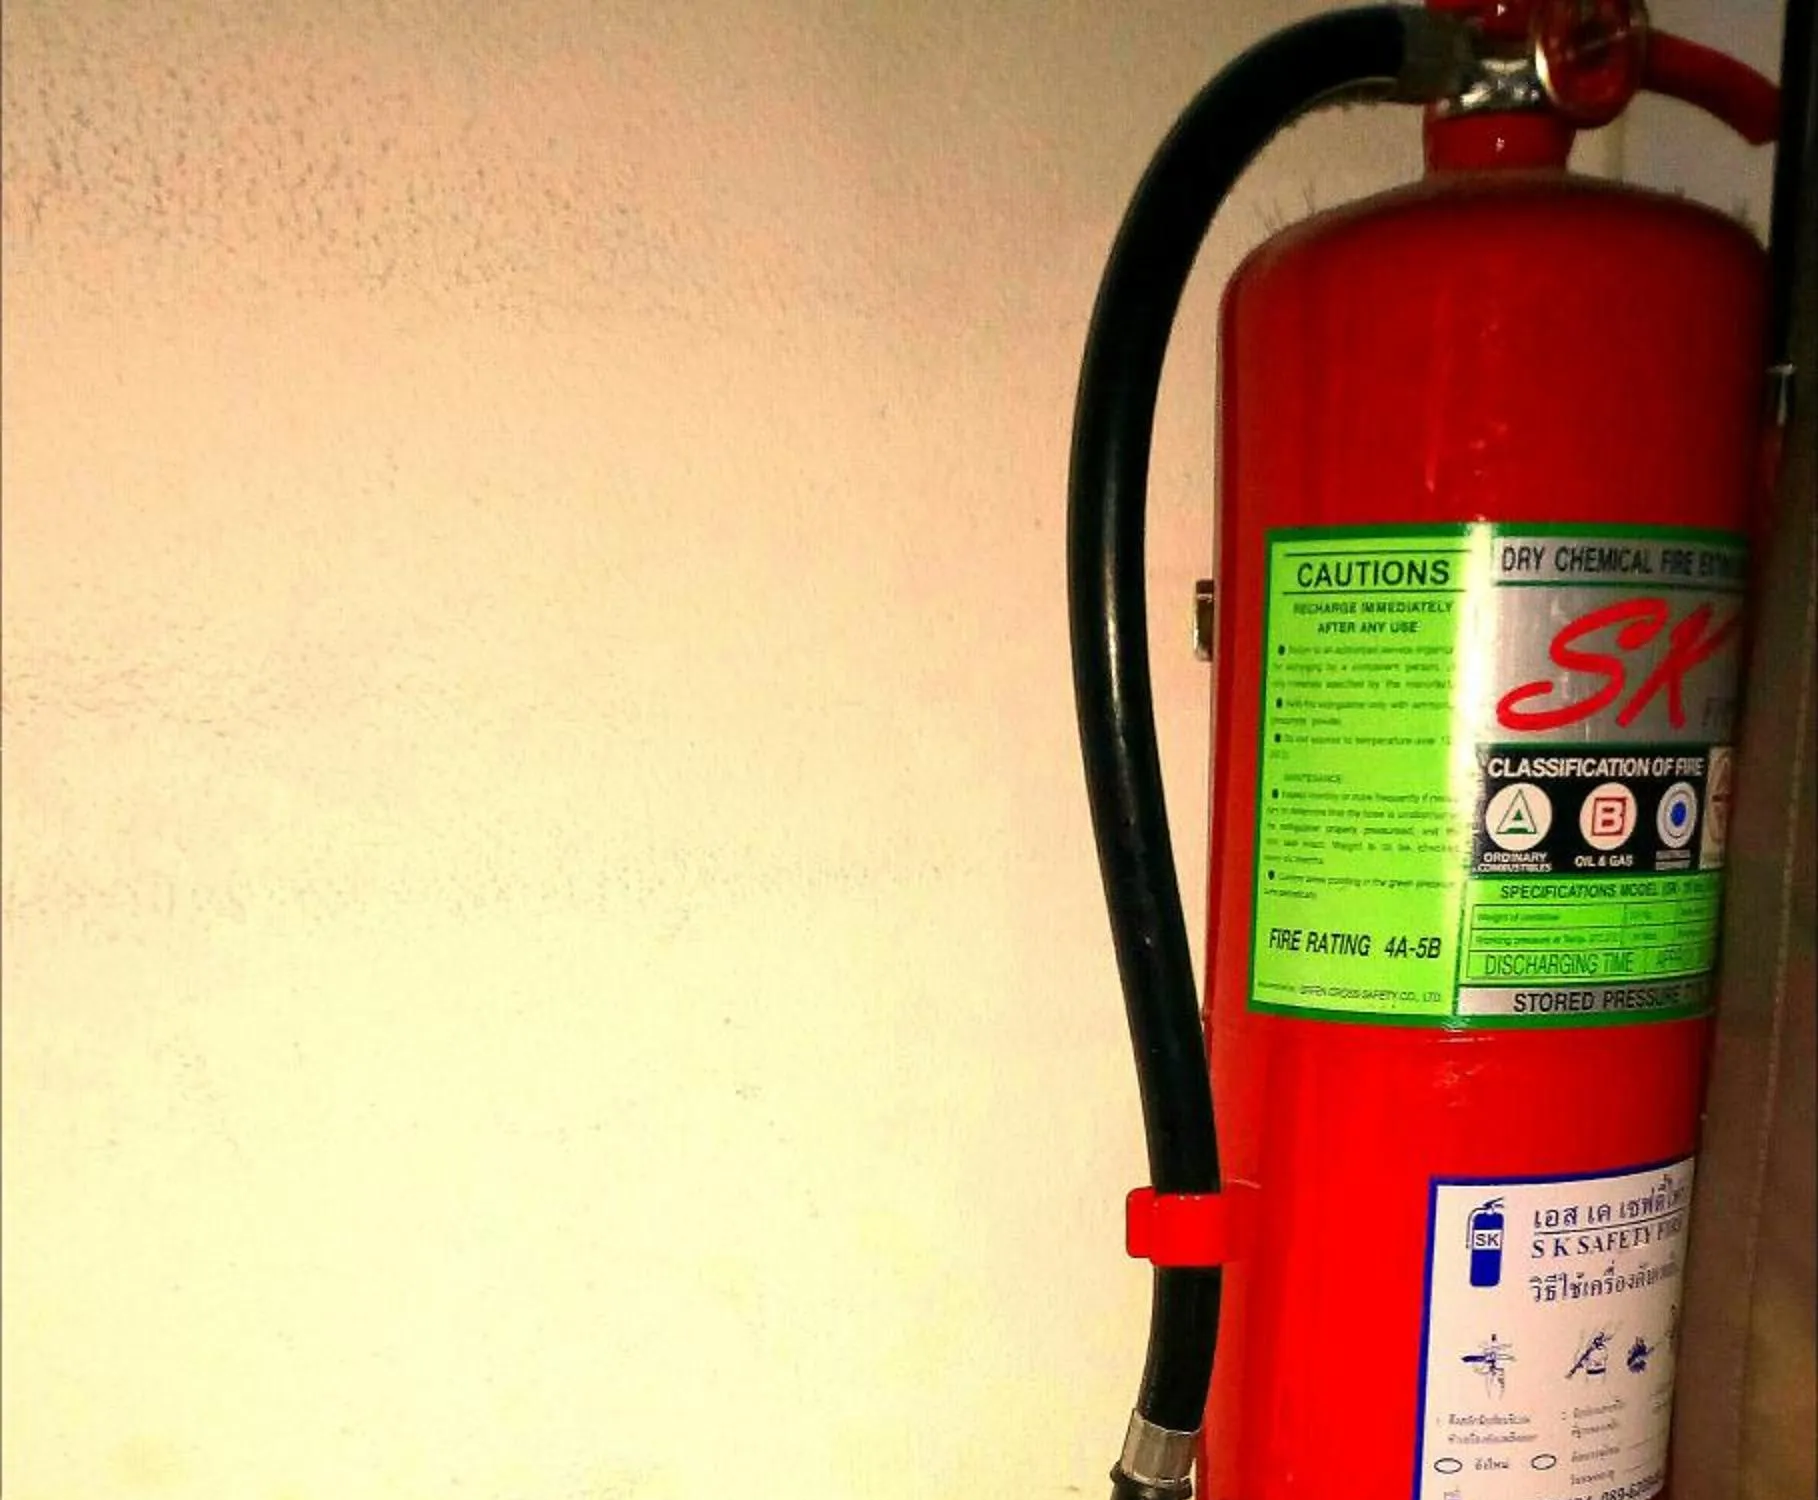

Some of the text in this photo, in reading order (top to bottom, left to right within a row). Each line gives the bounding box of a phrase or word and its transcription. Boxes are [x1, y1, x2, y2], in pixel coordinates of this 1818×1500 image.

[1501, 546, 1545, 573] DRY
[1554, 546, 1653, 575] CHEMICAL
[1297, 560, 1449, 588] CAUTIONS
[1293, 600, 1453, 614] RECHARGE IMMEDIATELY
[1317, 621, 1419, 634] AFTER ANY USE
[1487, 756, 1650, 779] CLASSIFICATION
[1652, 757, 1675, 777] OF
[1483, 851, 1548, 864] ORDINARY
[1574, 854, 1634, 868] OIL & GAS
[1500, 883, 1617, 899] SPECIFICATIONS
[1269, 928, 1442, 960] FIRE RATING 4A-5B
[1484, 951, 1634, 976] DISCHARGING TIME
[1513, 990, 1595, 1013] STORED
[1534, 1206, 1579, 1228] เอส
[1587, 1203, 1611, 1224] เค
[1475, 1233, 1500, 1247] SK
[1577, 1226, 1651, 1255] SAFETY
